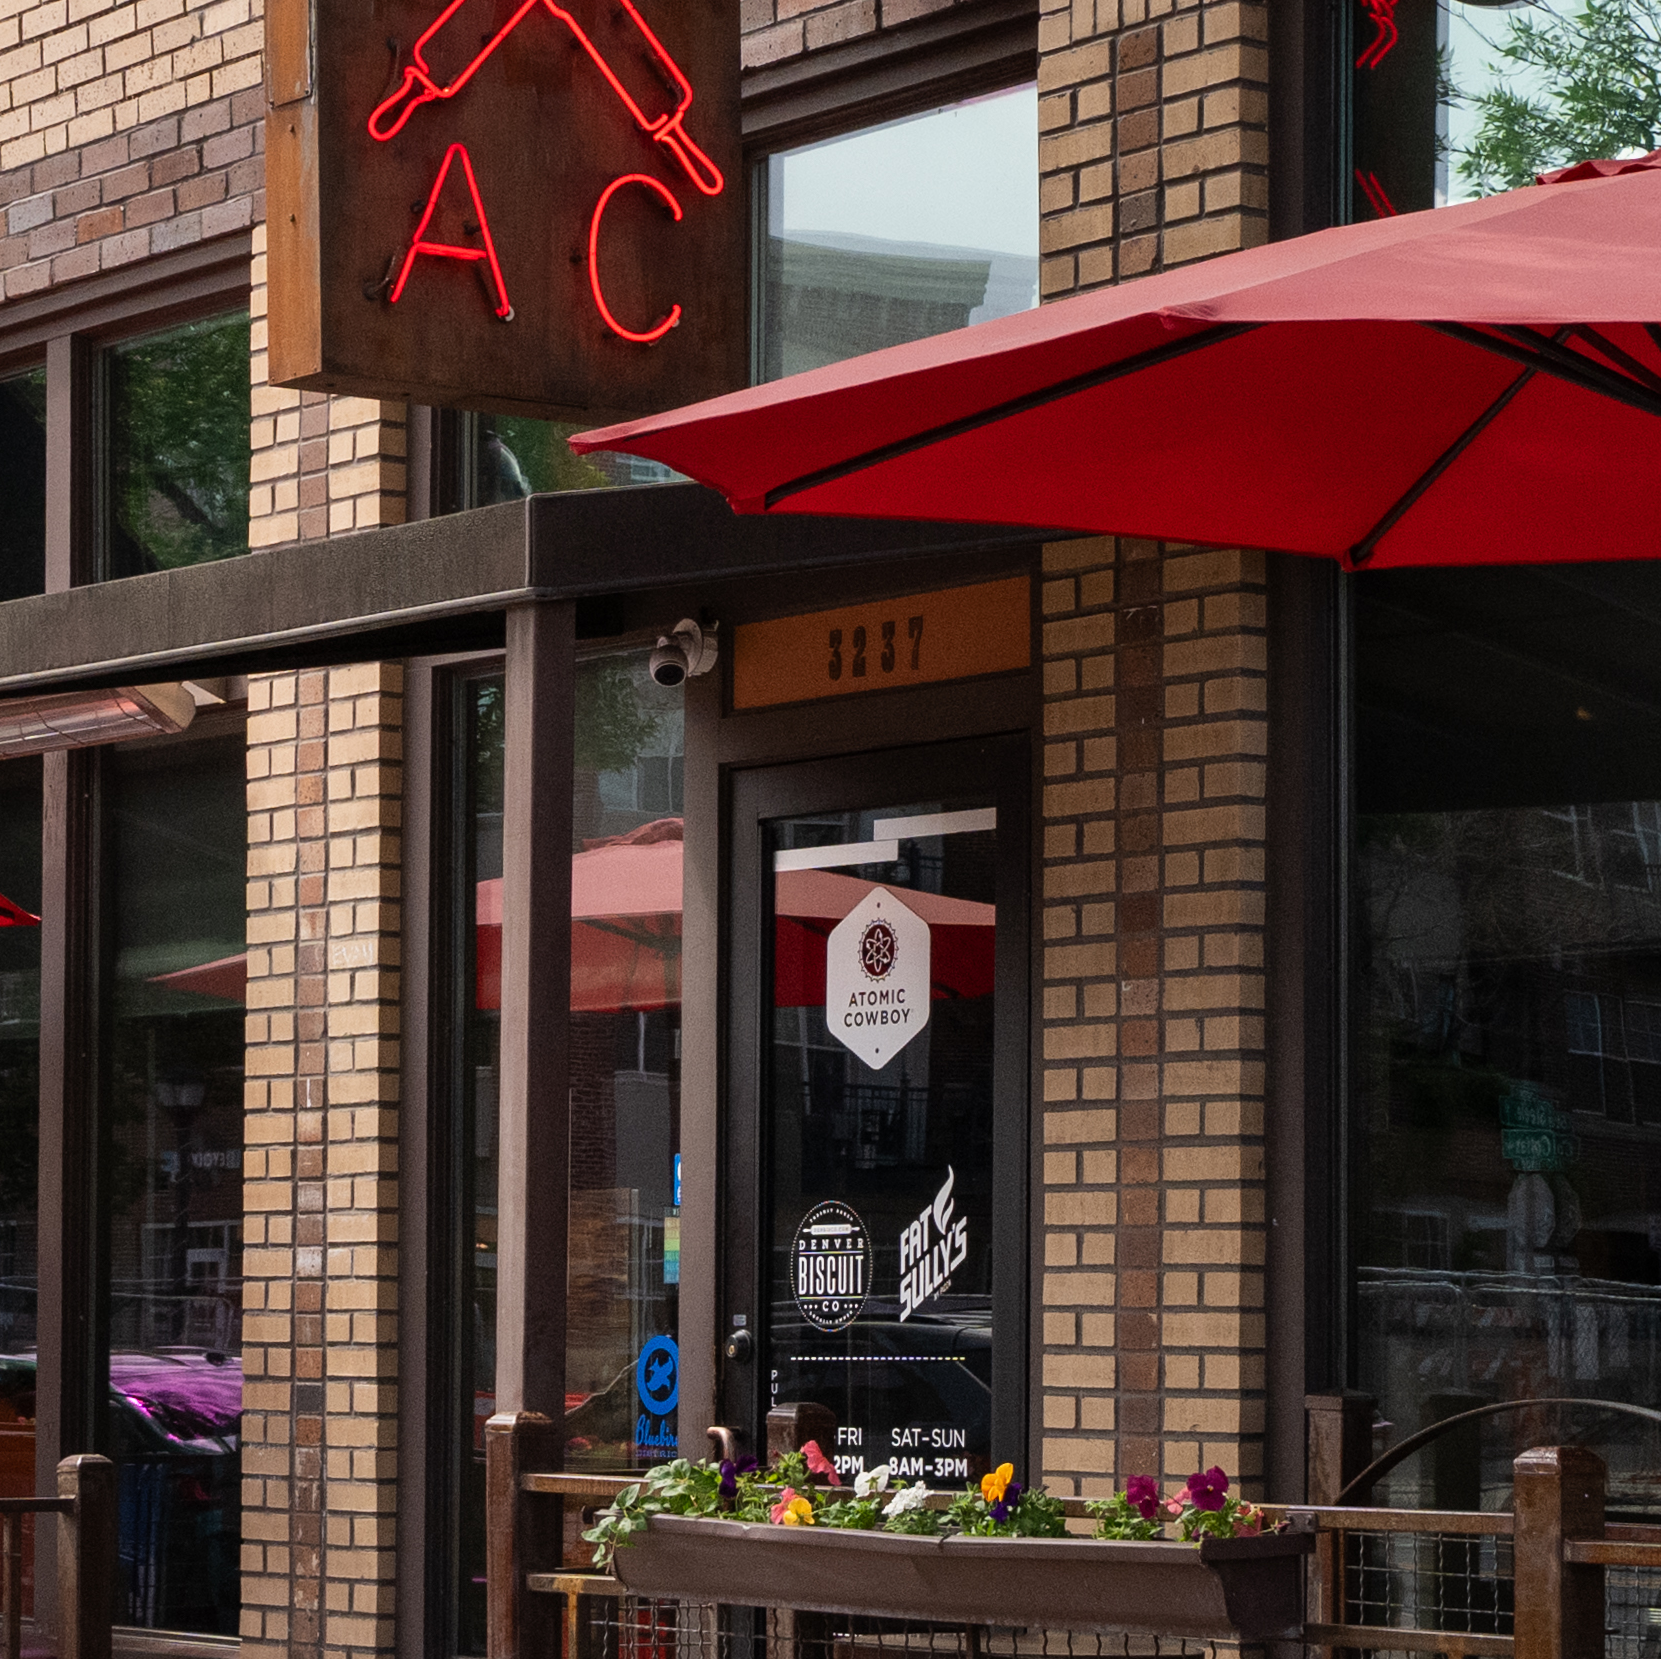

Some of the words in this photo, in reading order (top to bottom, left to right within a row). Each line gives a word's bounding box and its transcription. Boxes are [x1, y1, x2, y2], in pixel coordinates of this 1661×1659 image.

[828, 615, 924, 681] 3237
[848, 989, 906, 1008] ATOMIC
[843, 1008, 911, 1028] COWBOY
[799, 1238, 864, 1251] DENVER
[900, 1204, 933, 1276] FAT
[798, 1255, 864, 1296] BISCUIT
[899, 1215, 968, 1323] SULLY'S
[822, 1300, 840, 1312] CO
[834, 1428, 862, 1446] FRI
[891, 1428, 965, 1448] SAT-SUN
[635, 1449, 678, 1458] DISTRIC
[833, 1456, 864, 1476] 2PM
[890, 1457, 968, 1478] 8AM-3PM
